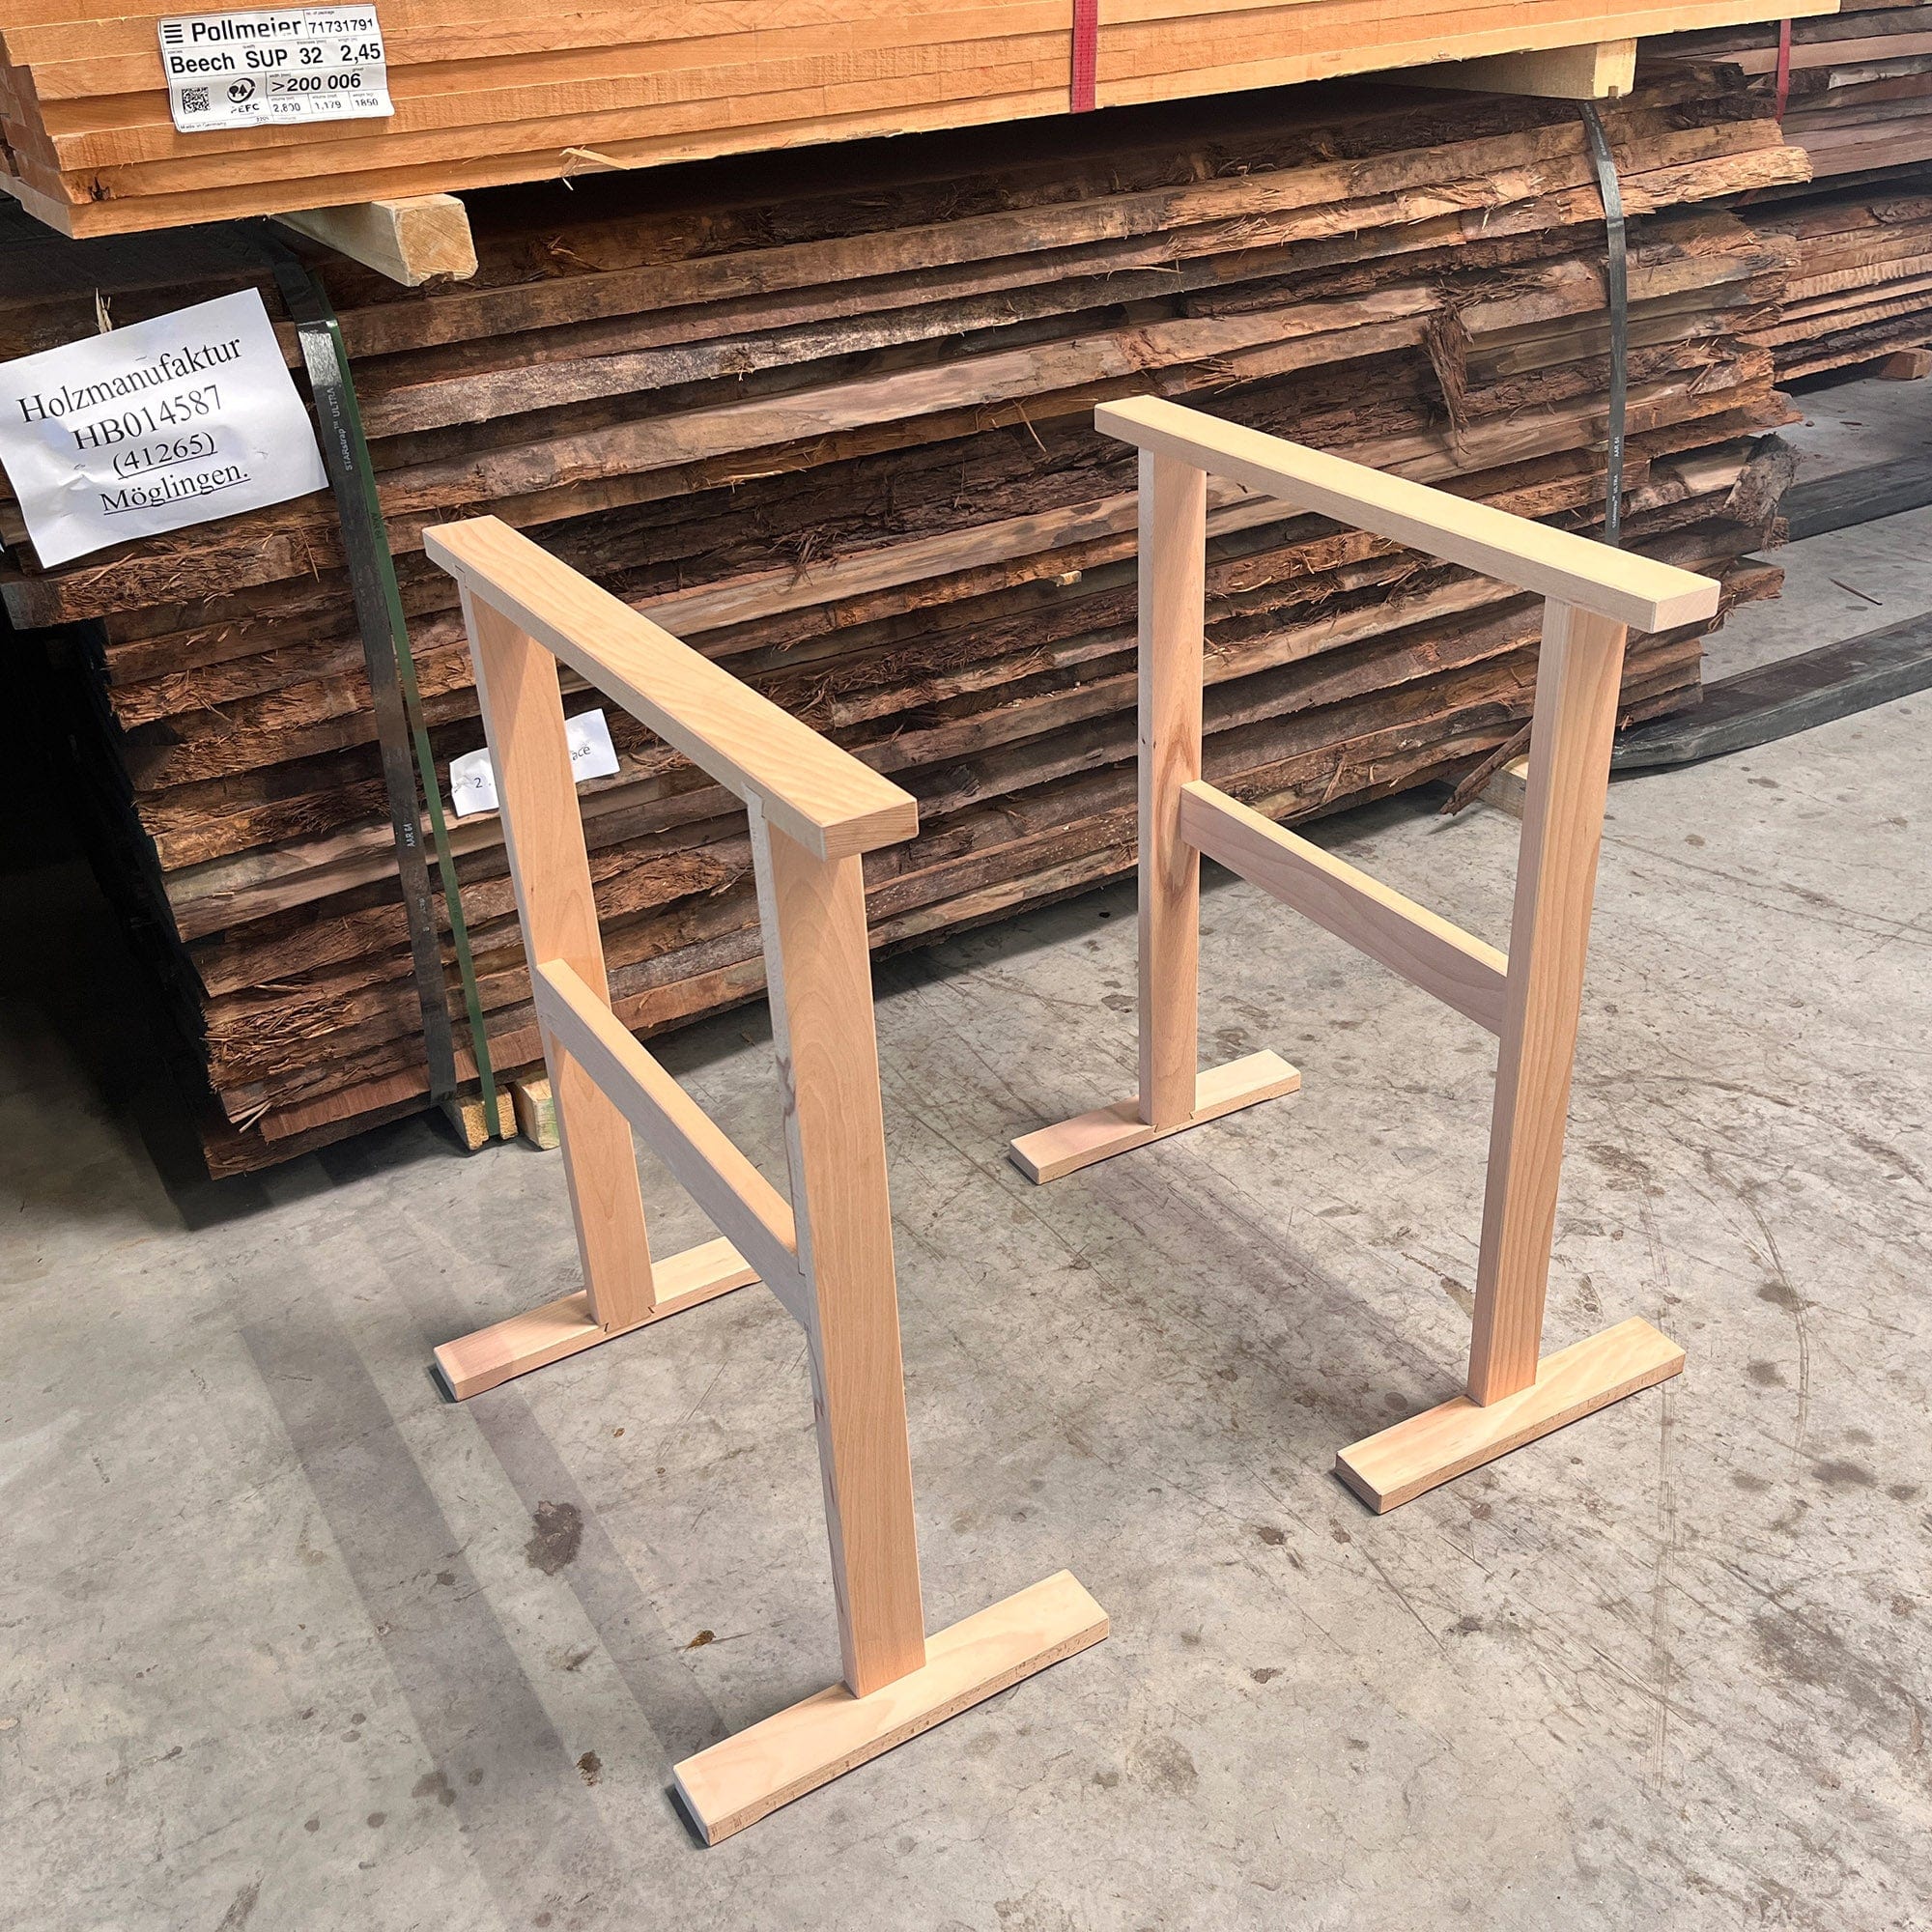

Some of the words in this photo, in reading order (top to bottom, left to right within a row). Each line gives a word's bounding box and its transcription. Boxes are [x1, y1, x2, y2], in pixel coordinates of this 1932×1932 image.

[191, 16, 302, 43] Pollmeier
[308, 17, 373, 35] 71731791
[169, 52, 236, 73] Beech
[245, 48, 288, 69] SUP
[298, 46, 324, 65] 32
[340, 43, 381, 65] 2,45
[271, 75, 322, 93] >200
[327, 72, 361, 90] 006
[15, 338, 242, 423] Holzmanufaktur
[72, 384, 222, 450] HB014587
[327, 387, 340, 417] ULTRA
[112, 431, 216, 479] (41265)
[99, 464, 248, 512] Möglingen.
[473, 777, 483, 788] 2
